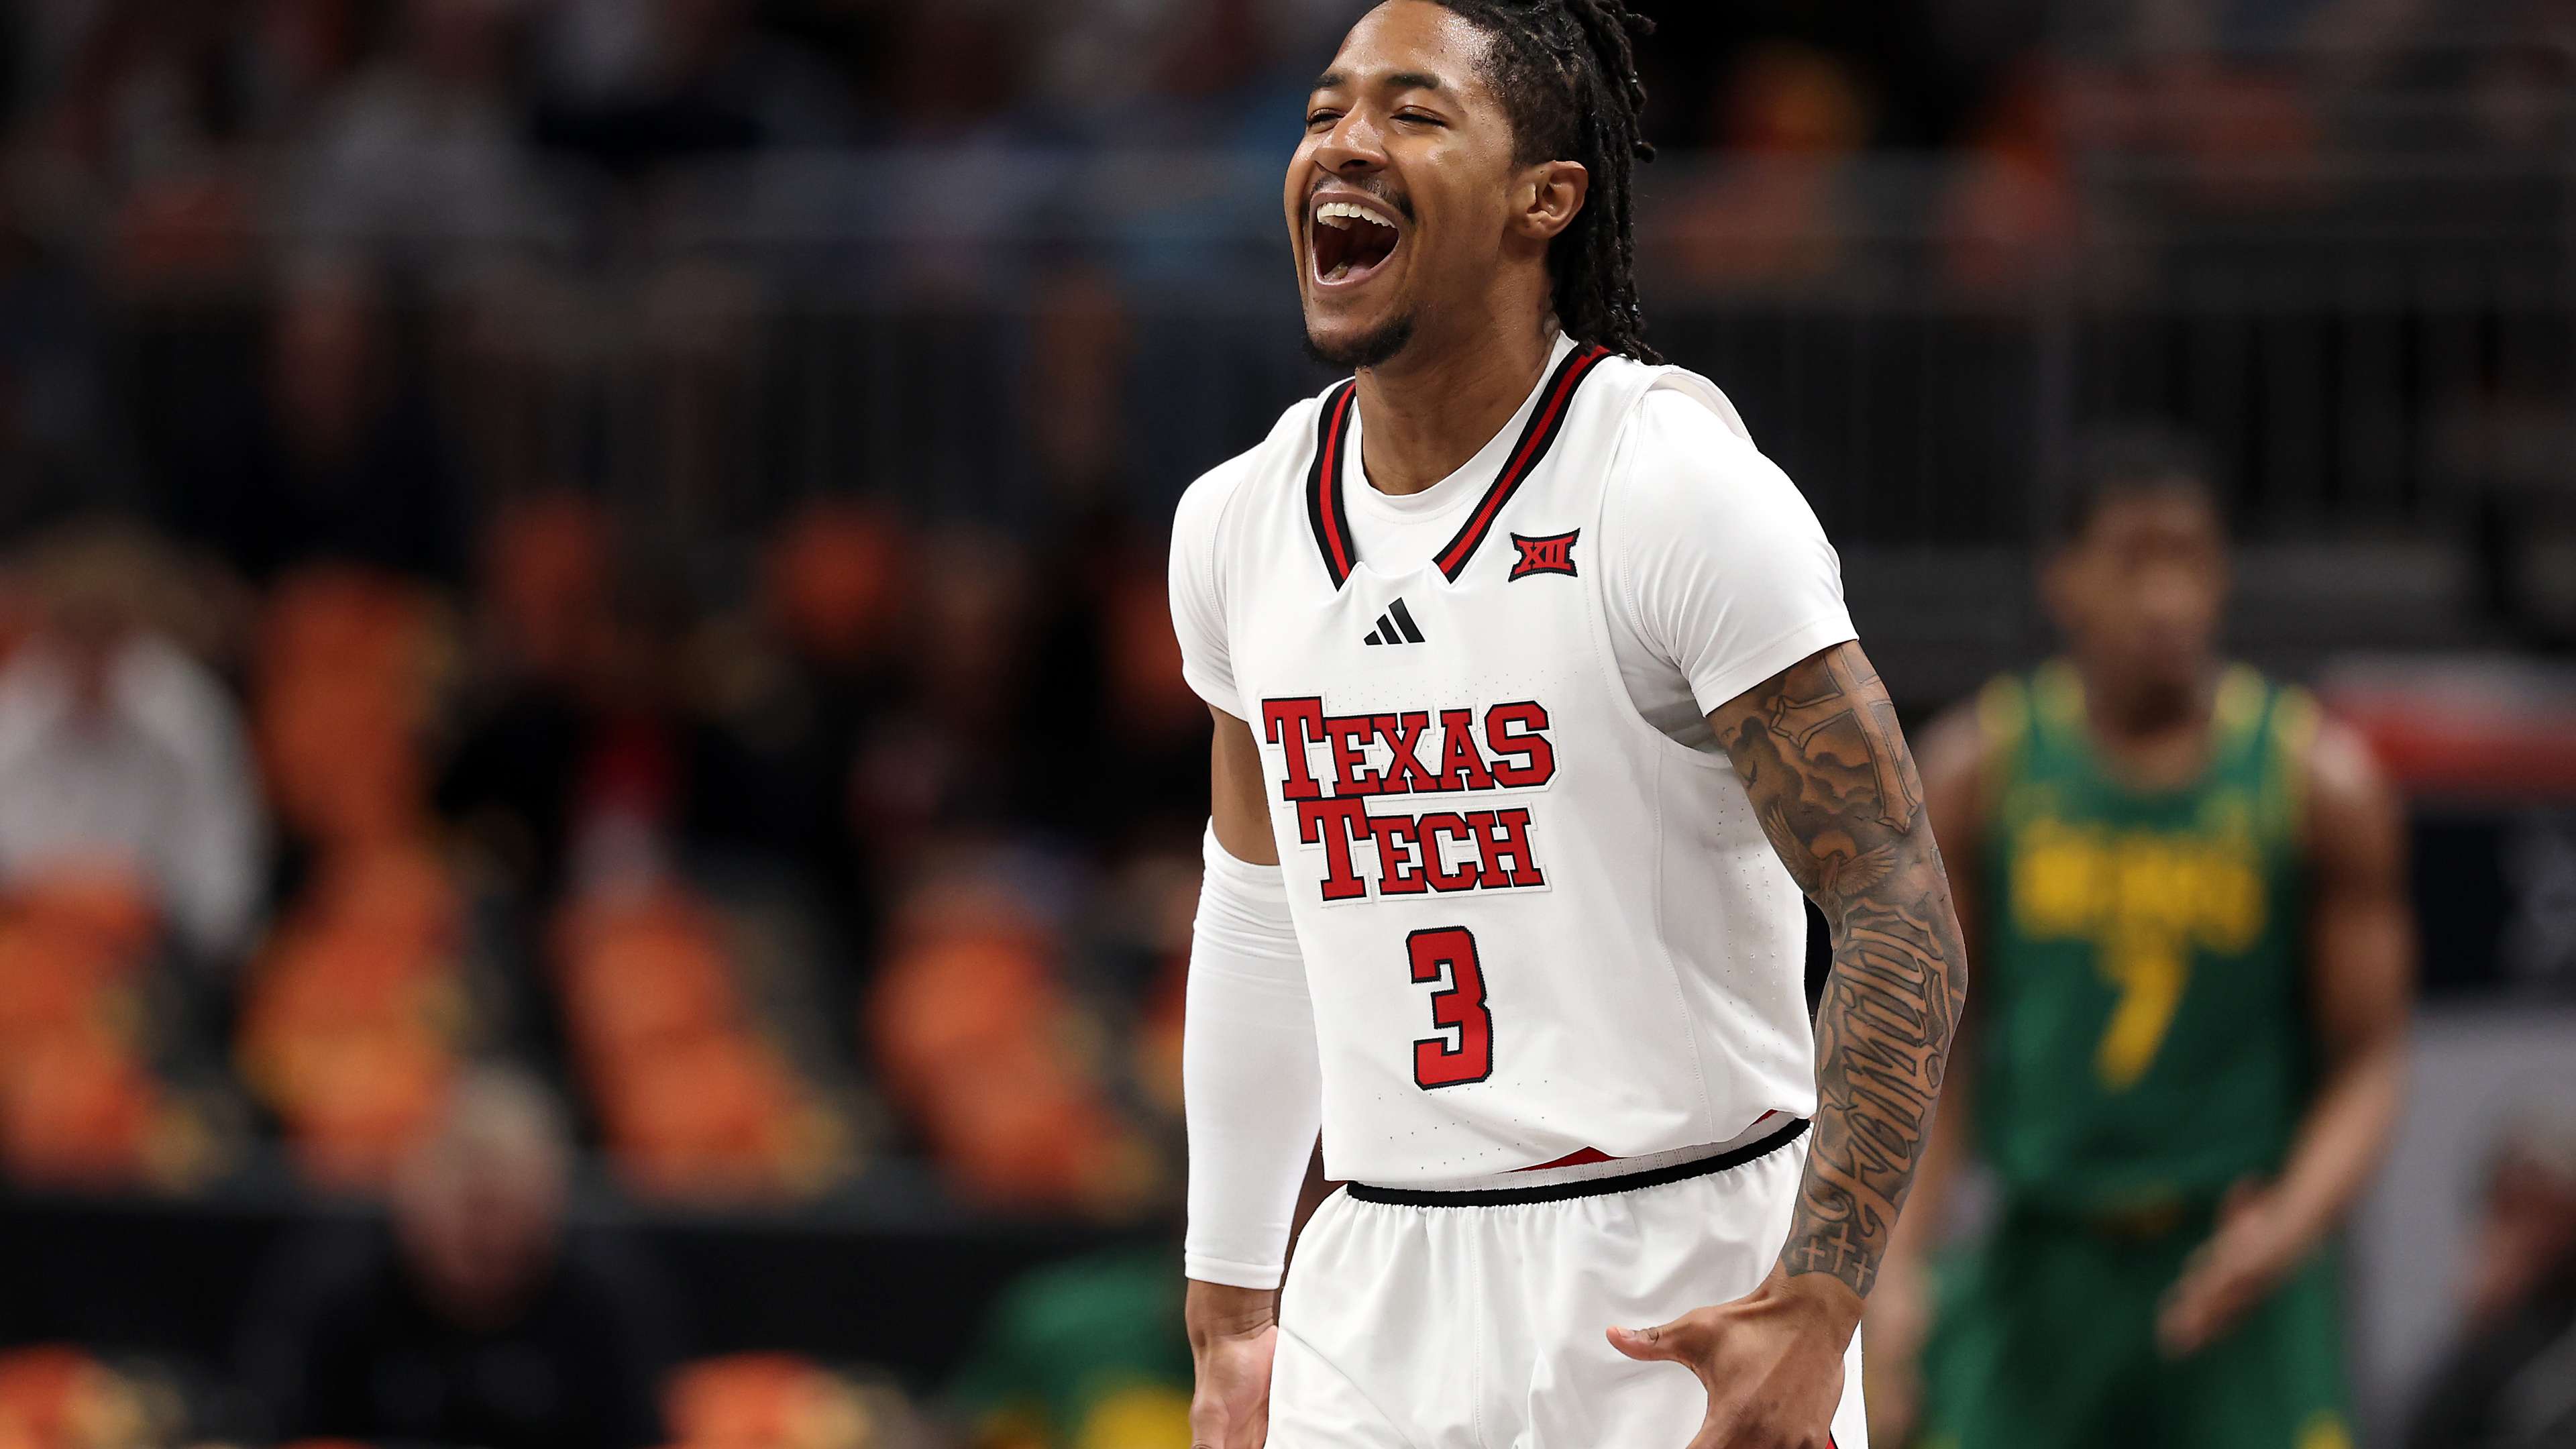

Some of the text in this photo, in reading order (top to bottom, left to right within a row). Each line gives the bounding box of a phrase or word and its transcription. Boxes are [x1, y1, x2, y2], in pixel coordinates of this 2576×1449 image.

[1513, 533, 1576, 578] XII
[1263, 696, 1555, 800] TEXAS
[1298, 798, 1544, 900] TECH
[1406, 926, 1493, 1089] 3
[2094, 932, 2191, 1089] 7
